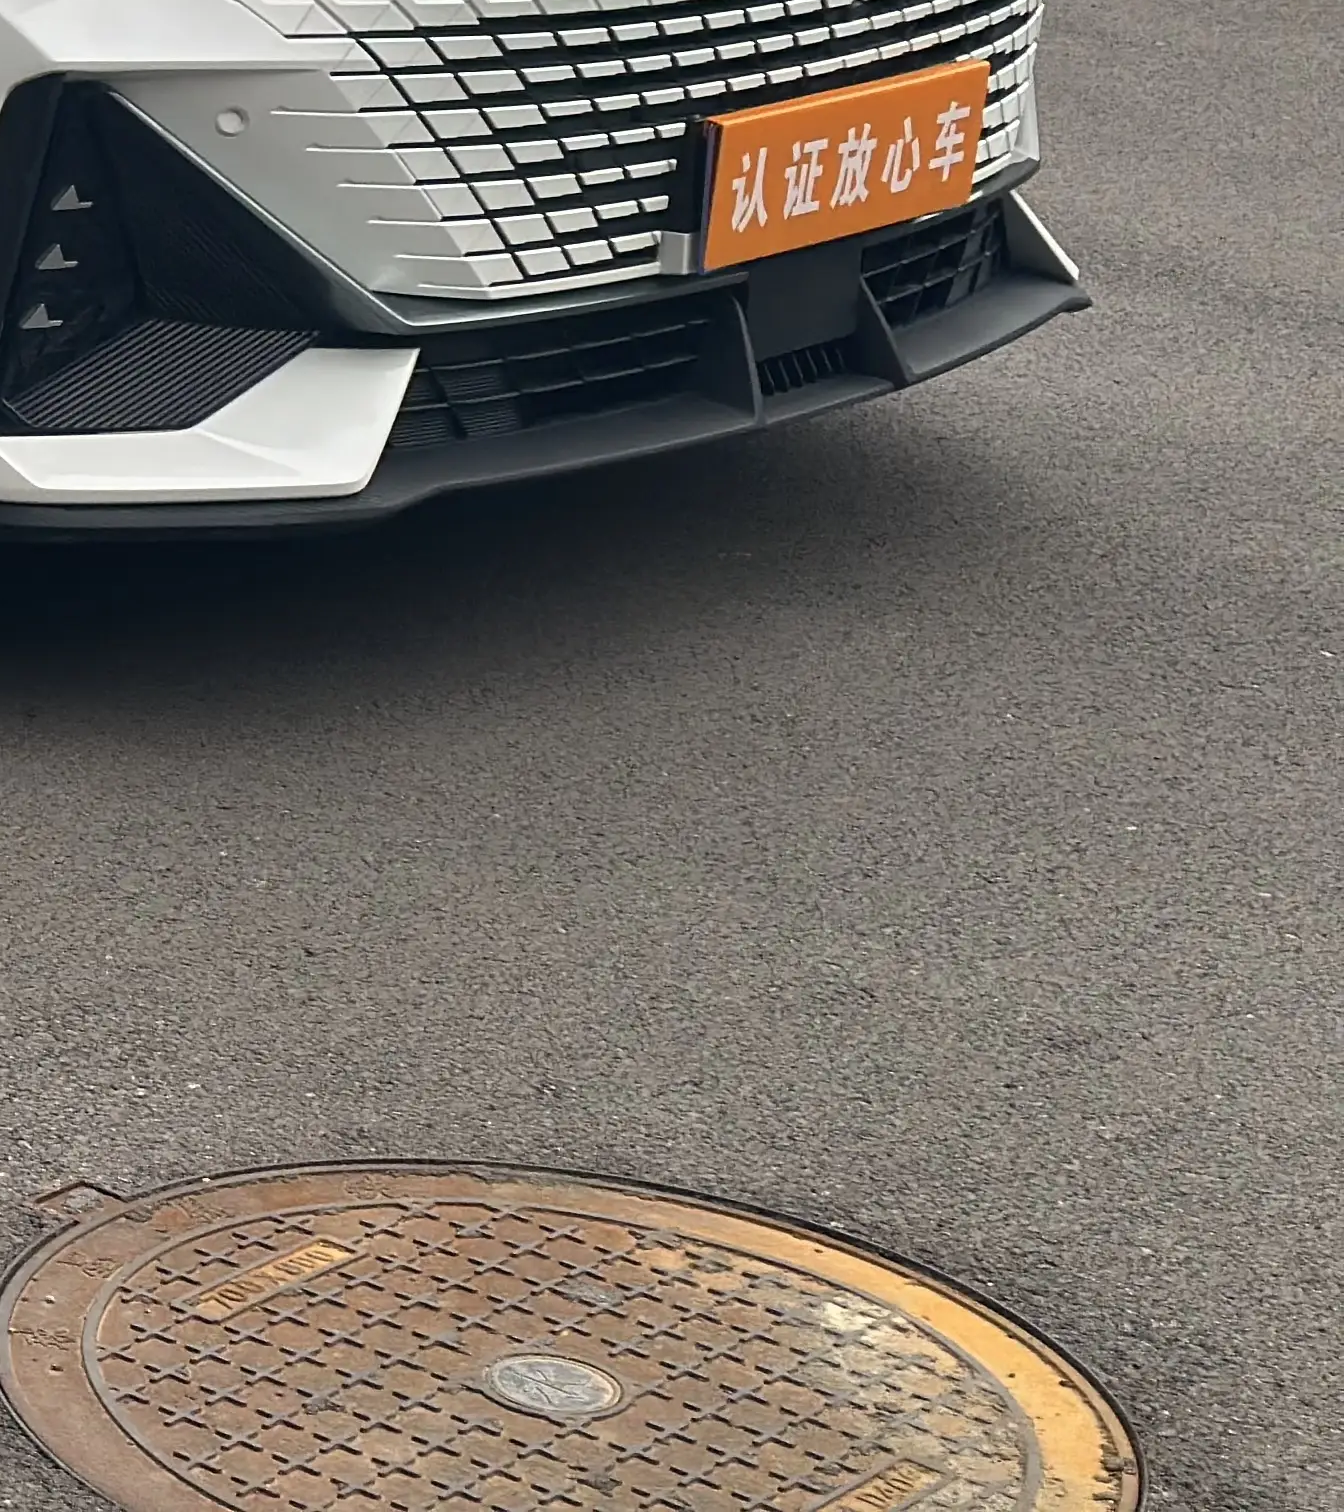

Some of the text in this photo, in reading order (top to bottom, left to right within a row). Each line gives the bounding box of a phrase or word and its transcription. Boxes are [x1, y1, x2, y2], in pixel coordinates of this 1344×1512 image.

[730, 100, 971, 233] 认证放心车
